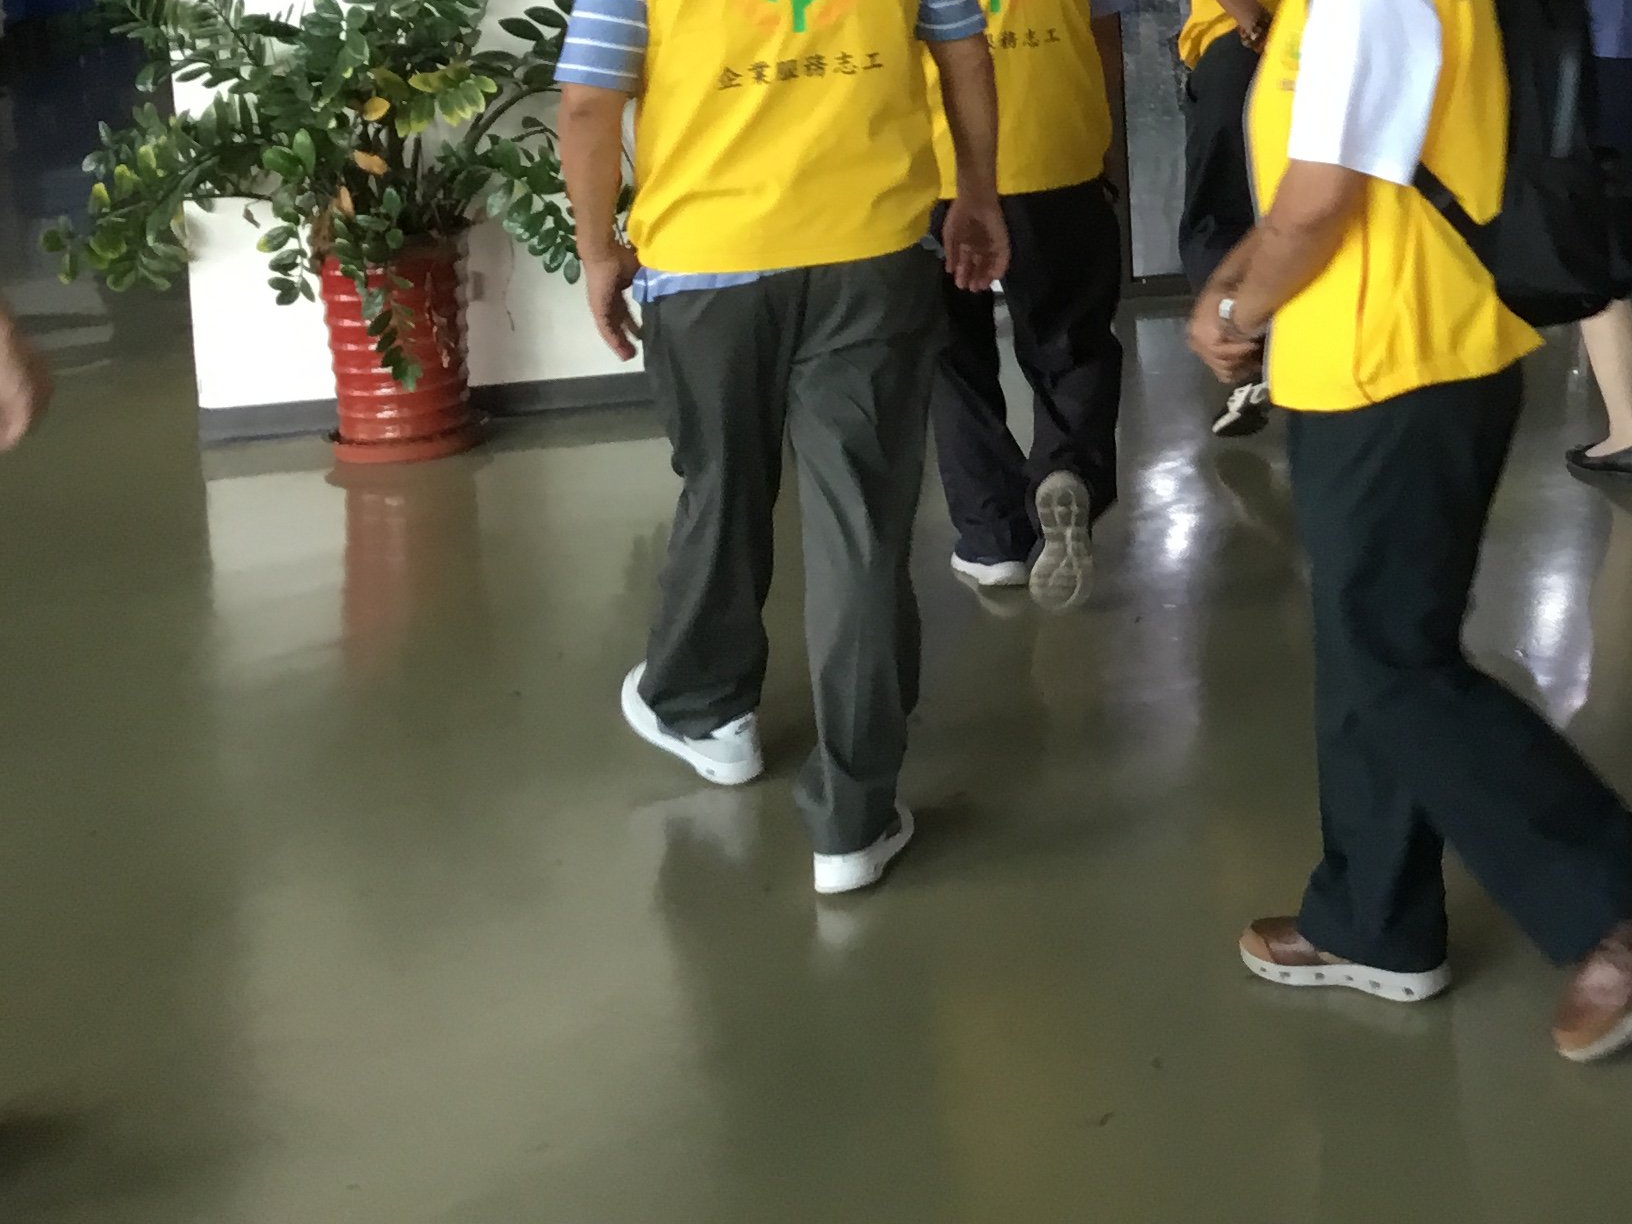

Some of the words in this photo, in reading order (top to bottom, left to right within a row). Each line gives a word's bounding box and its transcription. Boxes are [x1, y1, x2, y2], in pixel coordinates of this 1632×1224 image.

[717, 51, 884, 91] 企業服務志工
